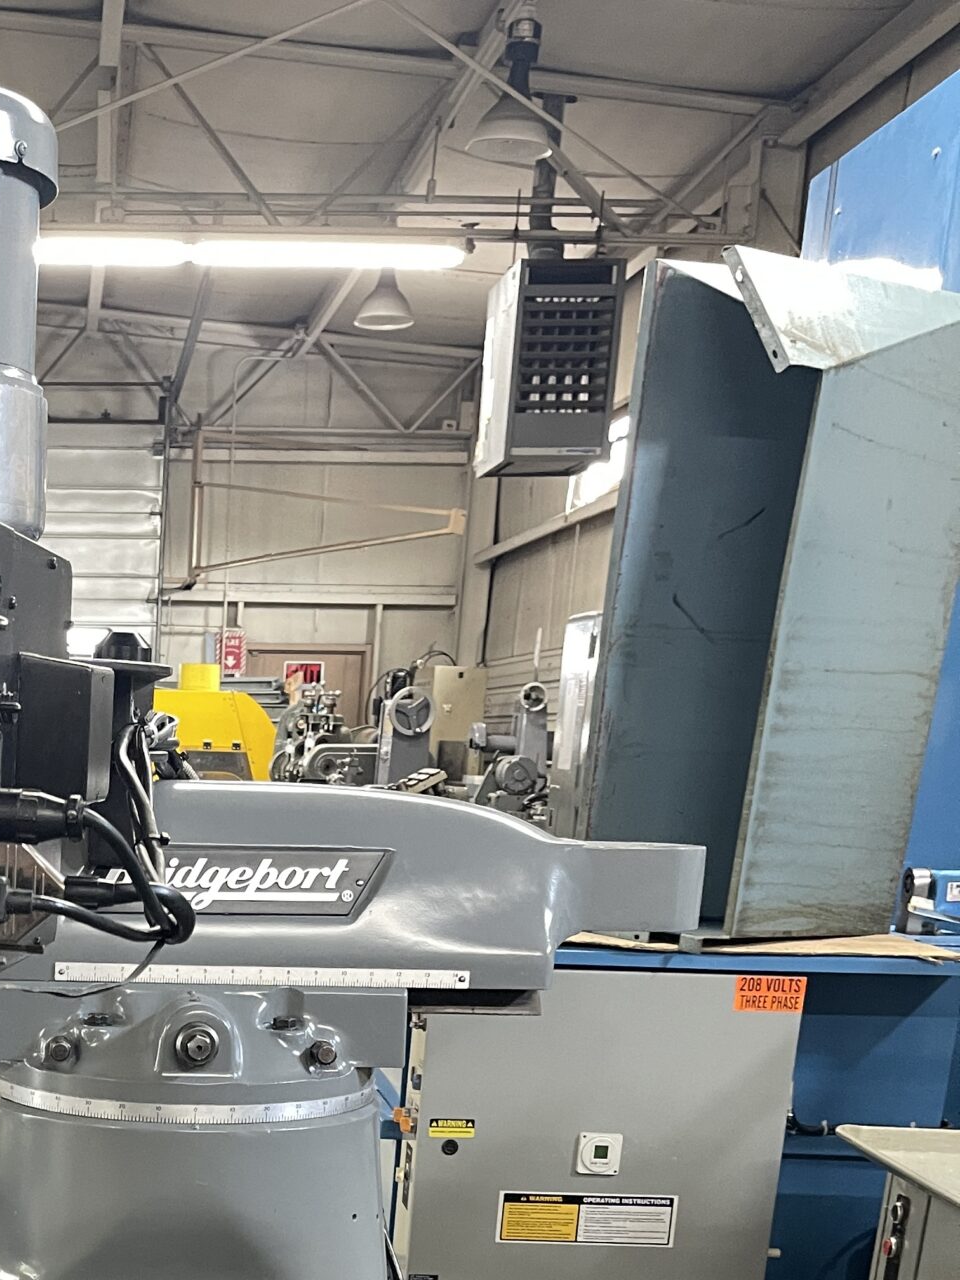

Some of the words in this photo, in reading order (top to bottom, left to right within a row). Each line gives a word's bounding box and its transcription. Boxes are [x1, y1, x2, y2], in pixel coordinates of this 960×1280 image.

[107, 857, 350, 911] idgeport
[739, 977, 762, 992] 208
[766, 978, 802, 993] VOLTS
[739, 994, 768, 1009] THREE
[770, 995, 801, 1010] PHASE
